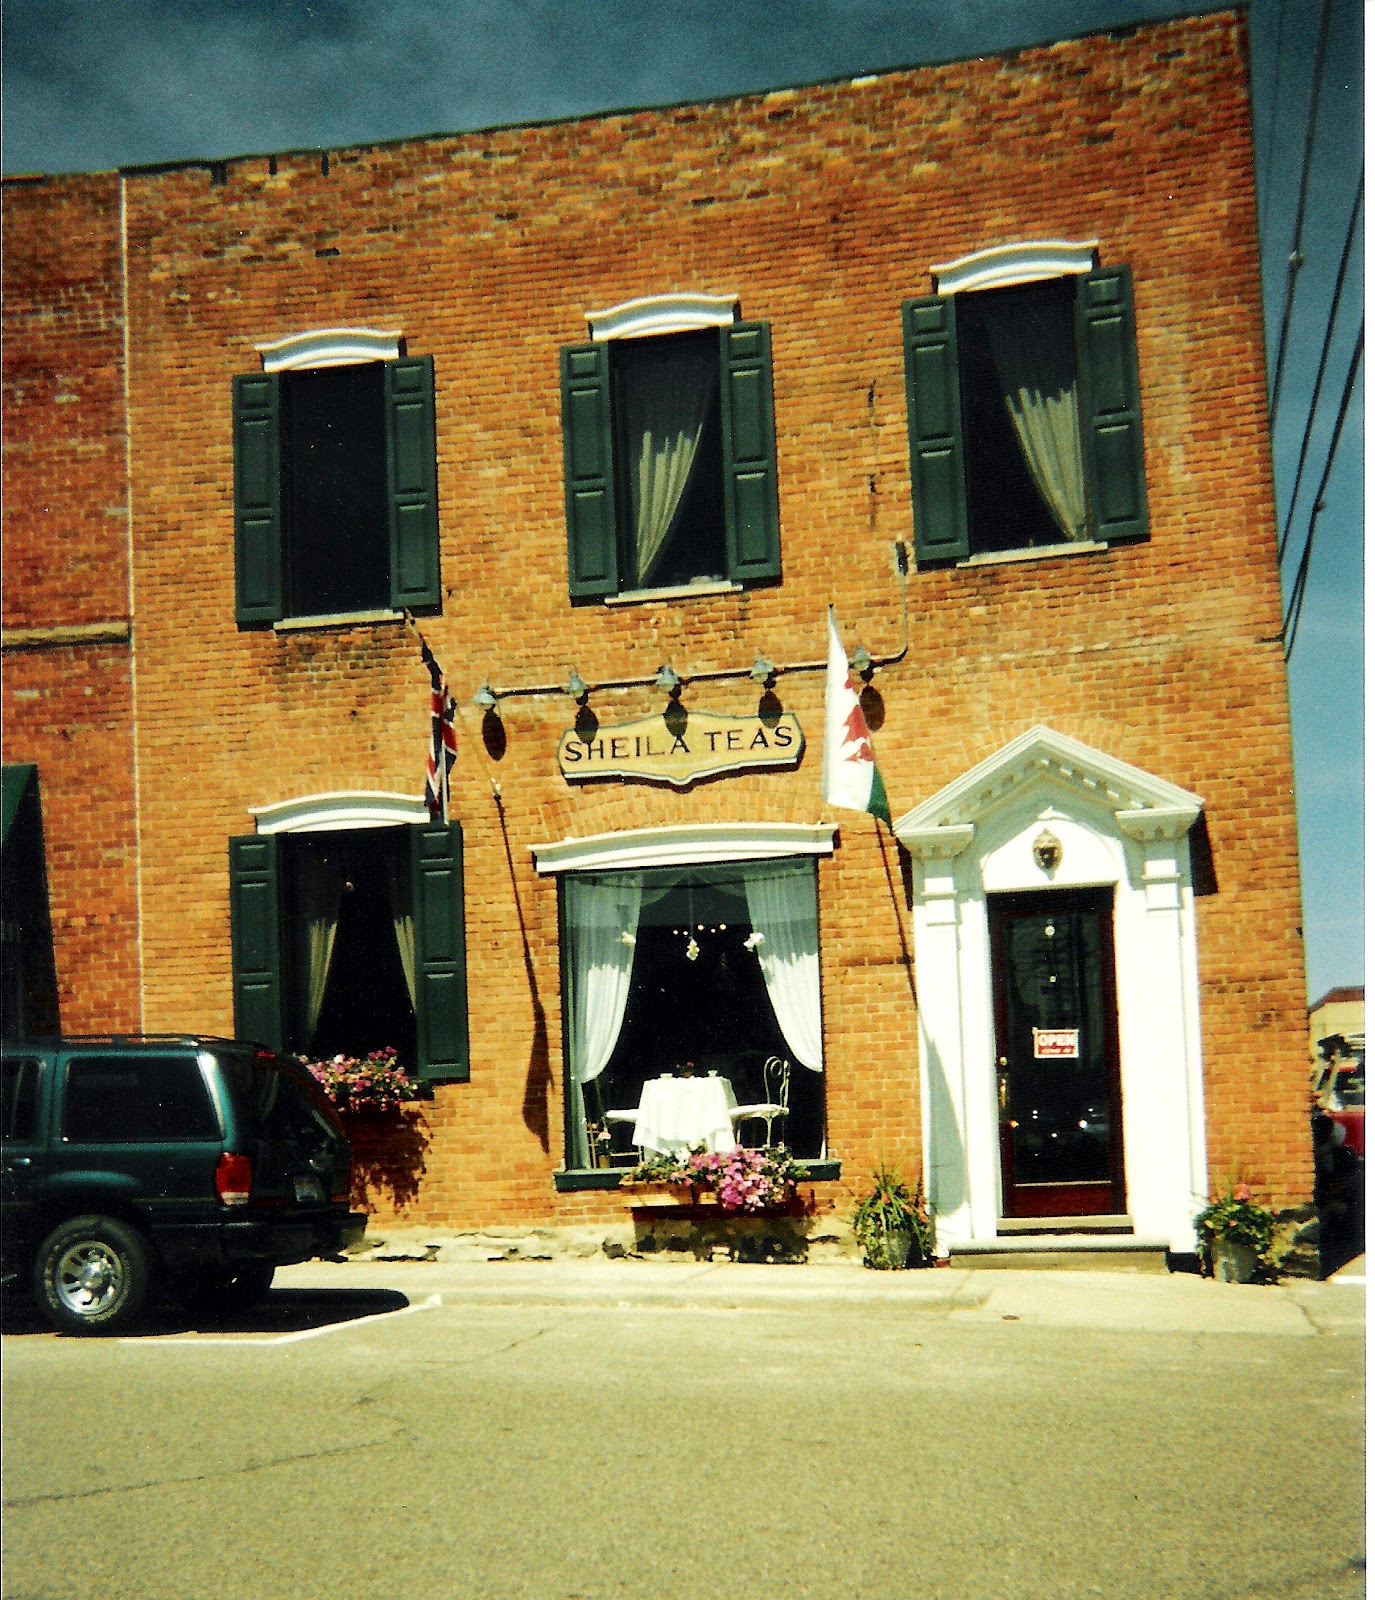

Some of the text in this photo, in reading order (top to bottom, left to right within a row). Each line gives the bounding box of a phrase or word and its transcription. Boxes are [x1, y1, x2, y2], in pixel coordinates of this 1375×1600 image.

[564, 725, 793, 762] SHEILA TEAS
[1037, 1033, 1075, 1046] OPEN
